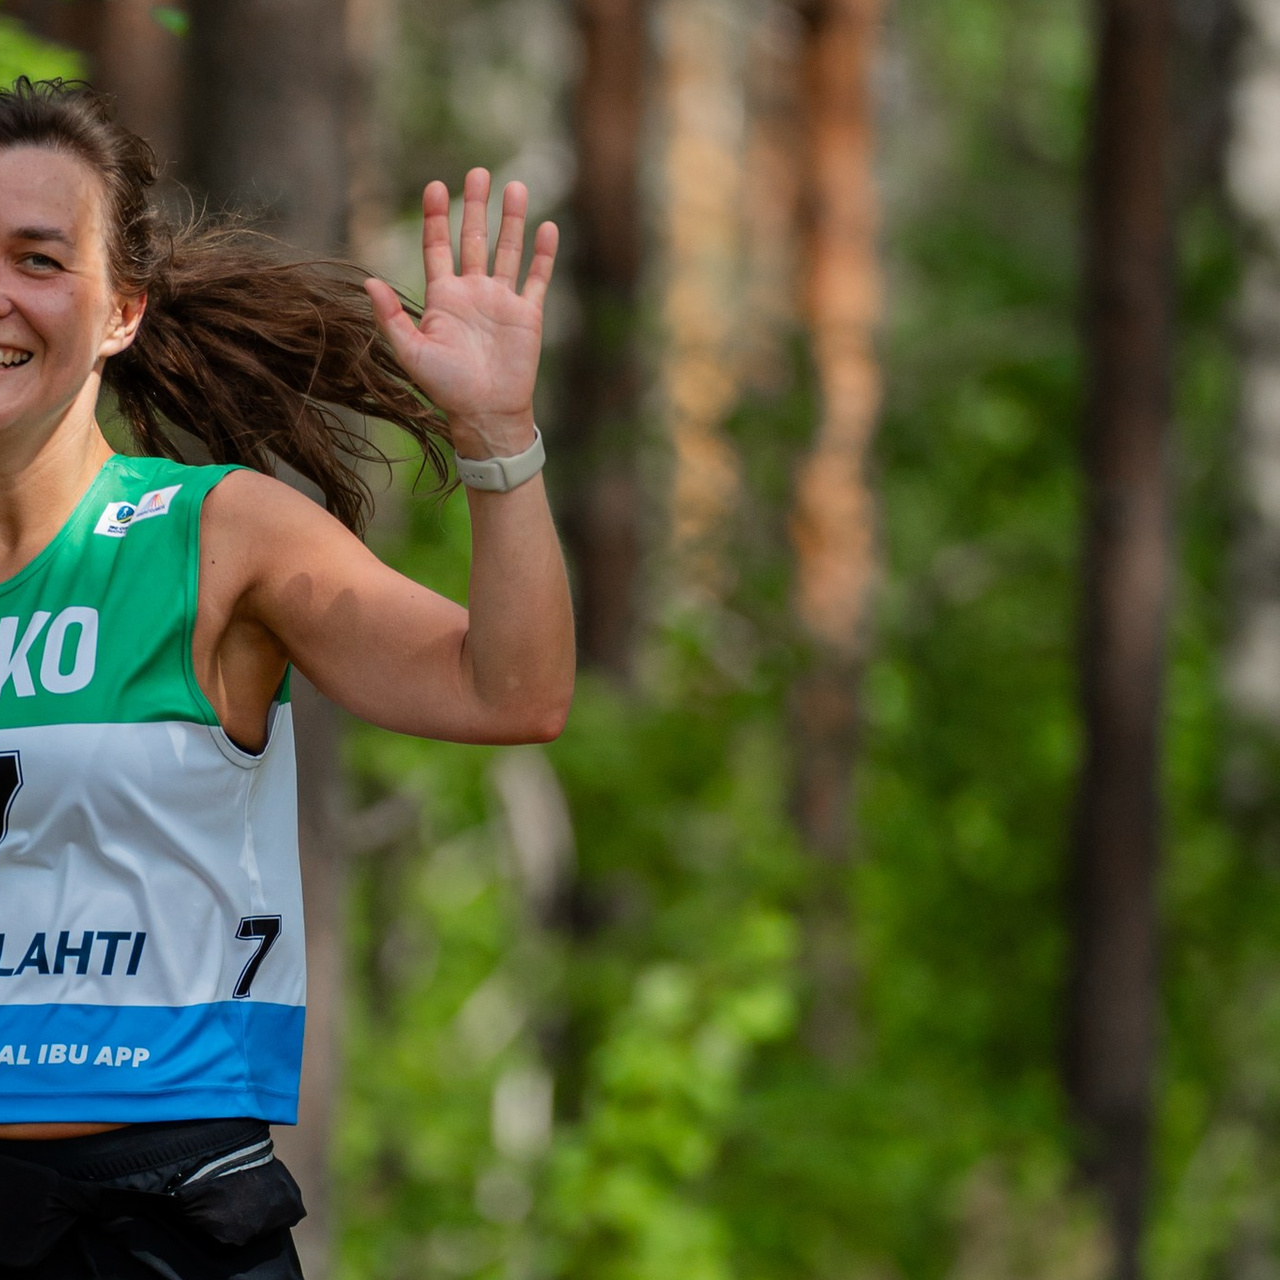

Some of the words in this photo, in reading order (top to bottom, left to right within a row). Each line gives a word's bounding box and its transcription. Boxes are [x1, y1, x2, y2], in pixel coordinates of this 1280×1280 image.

[232, 914, 282, 999] 7
[38, 1043, 89, 1066] IBU
[93, 1045, 150, 1068] APP
